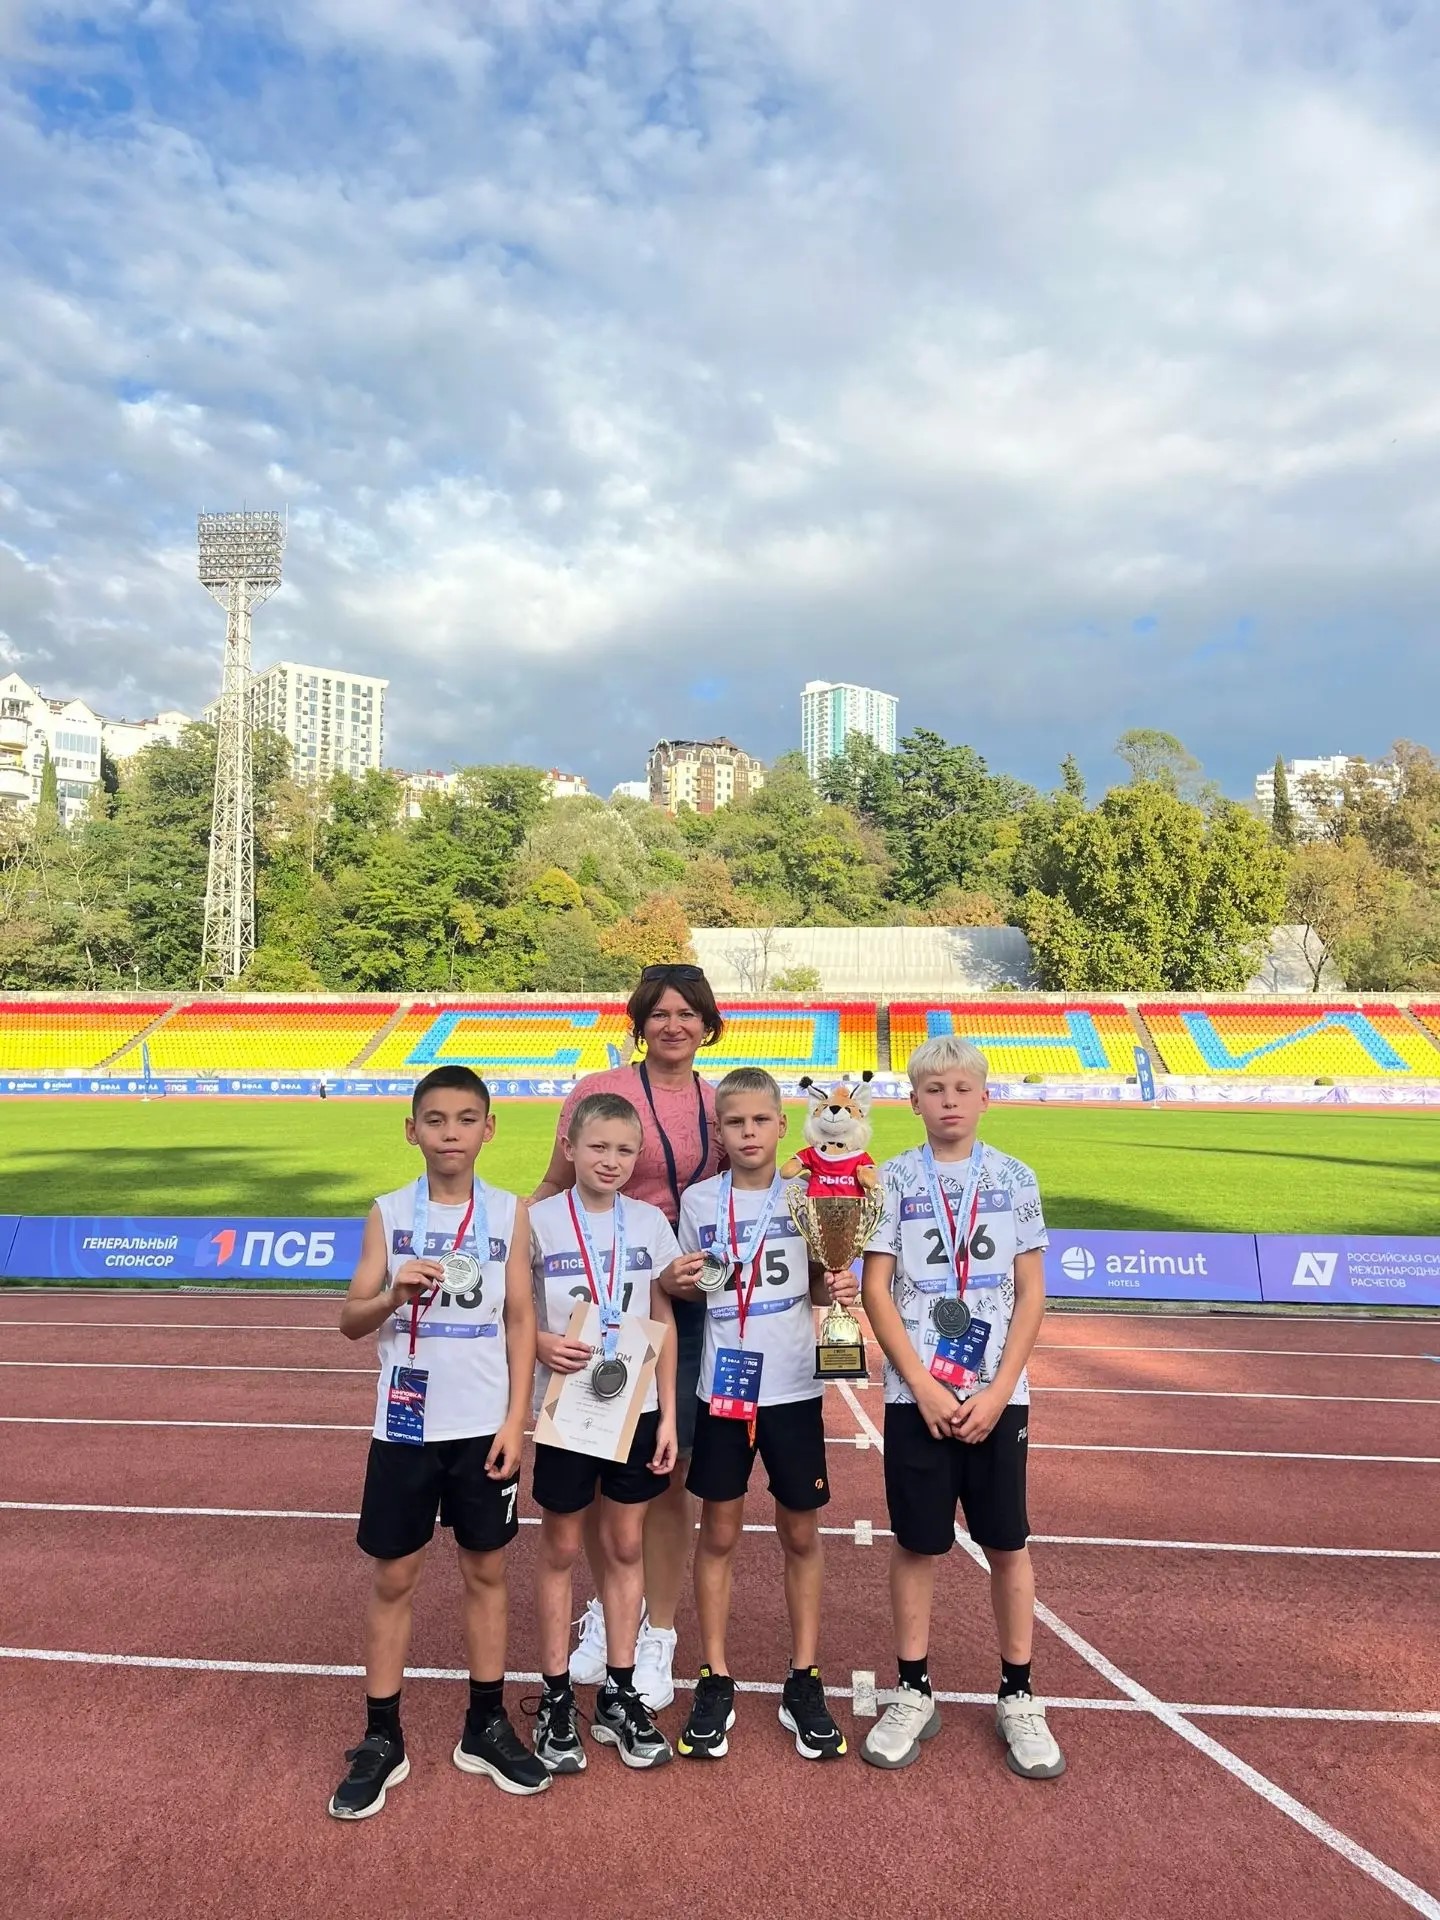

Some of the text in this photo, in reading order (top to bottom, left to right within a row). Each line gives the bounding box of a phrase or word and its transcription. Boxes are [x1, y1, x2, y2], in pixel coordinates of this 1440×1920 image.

[819, 1175, 855, 1186] РЫСЯ
[82, 1235, 178, 1250] ГЕНЕРАЛЬНЫЙ
[241, 1231, 335, 1267] ПСБ
[105, 1254, 174, 1267] СПОНСОР
[1105, 1249, 1208, 1276] azimut
[1347, 1251, 1421, 1263] РОССИЙСКАЯ
[1108, 1279, 1140, 1288] HOTELS
[1351, 1278, 1406, 1288] РАСЧЕТОВ
